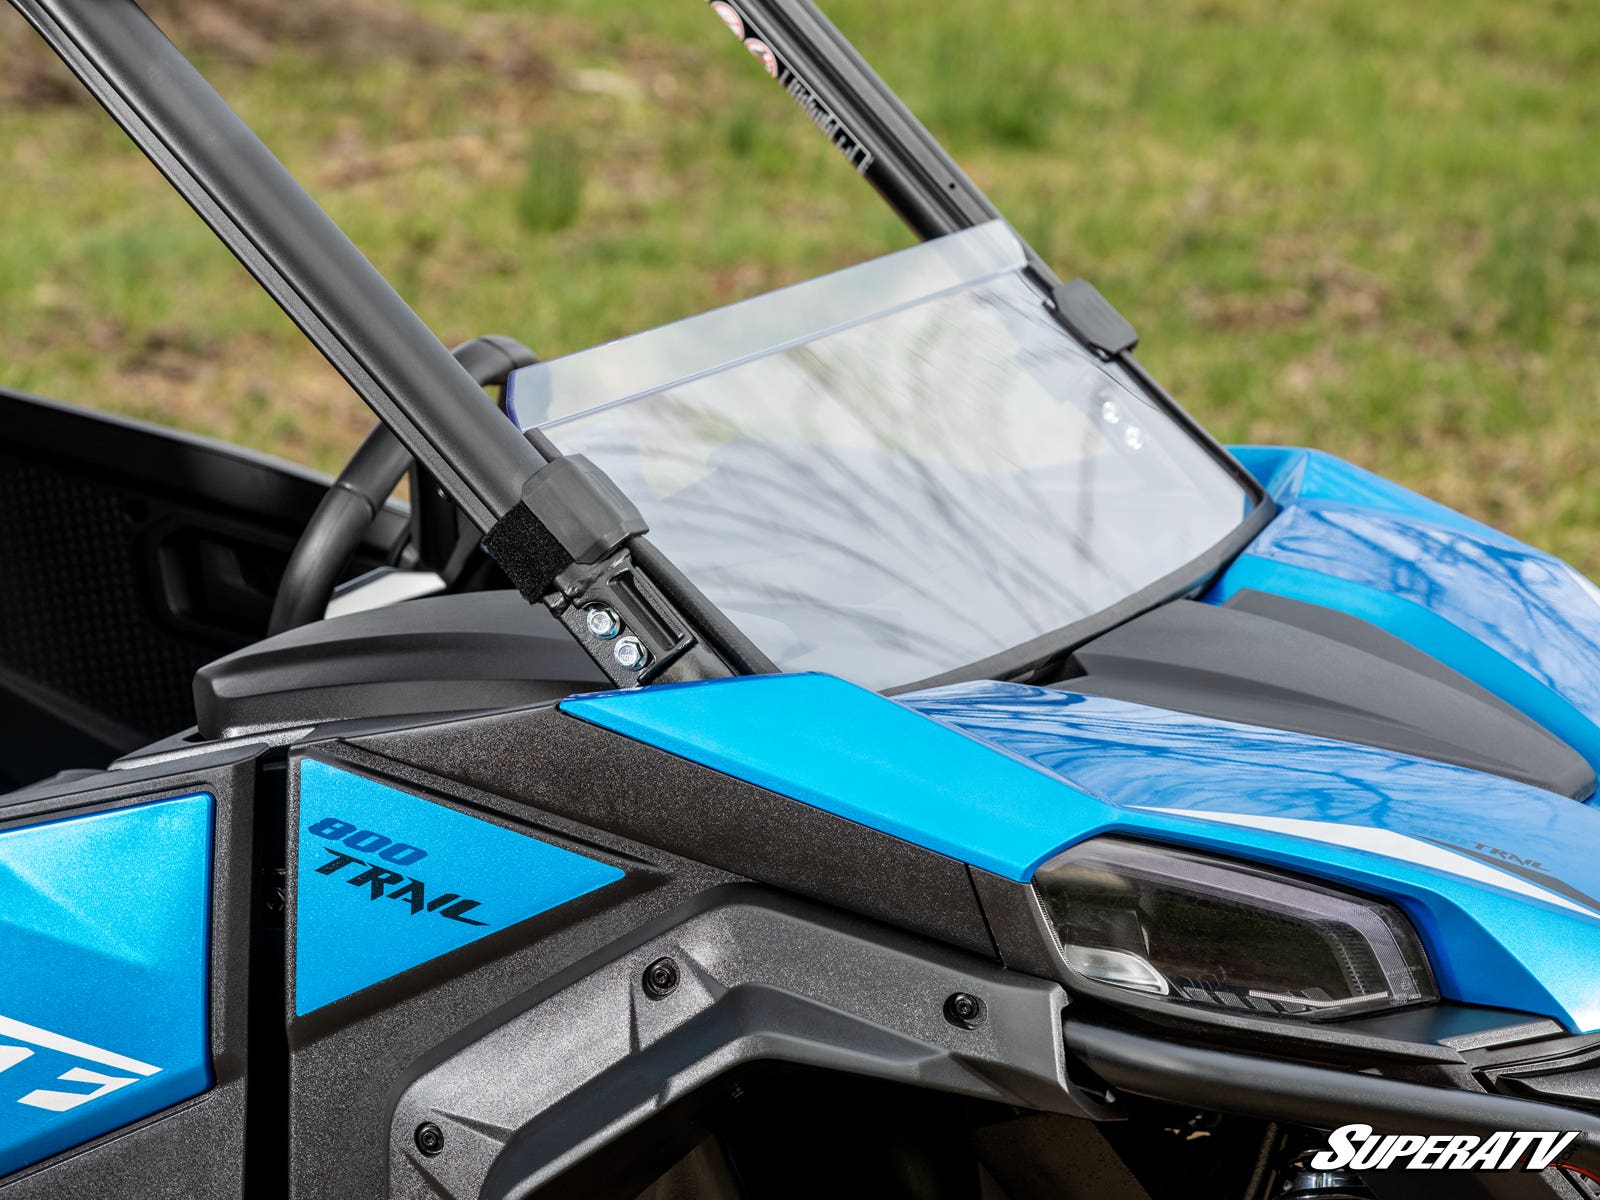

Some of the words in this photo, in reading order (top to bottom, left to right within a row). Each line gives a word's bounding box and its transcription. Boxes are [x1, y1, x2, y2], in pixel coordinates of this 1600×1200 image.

[307, 817, 429, 866] 800
[1472, 841, 1552, 872] TRAIL
[314, 846, 491, 926] TRAIL
